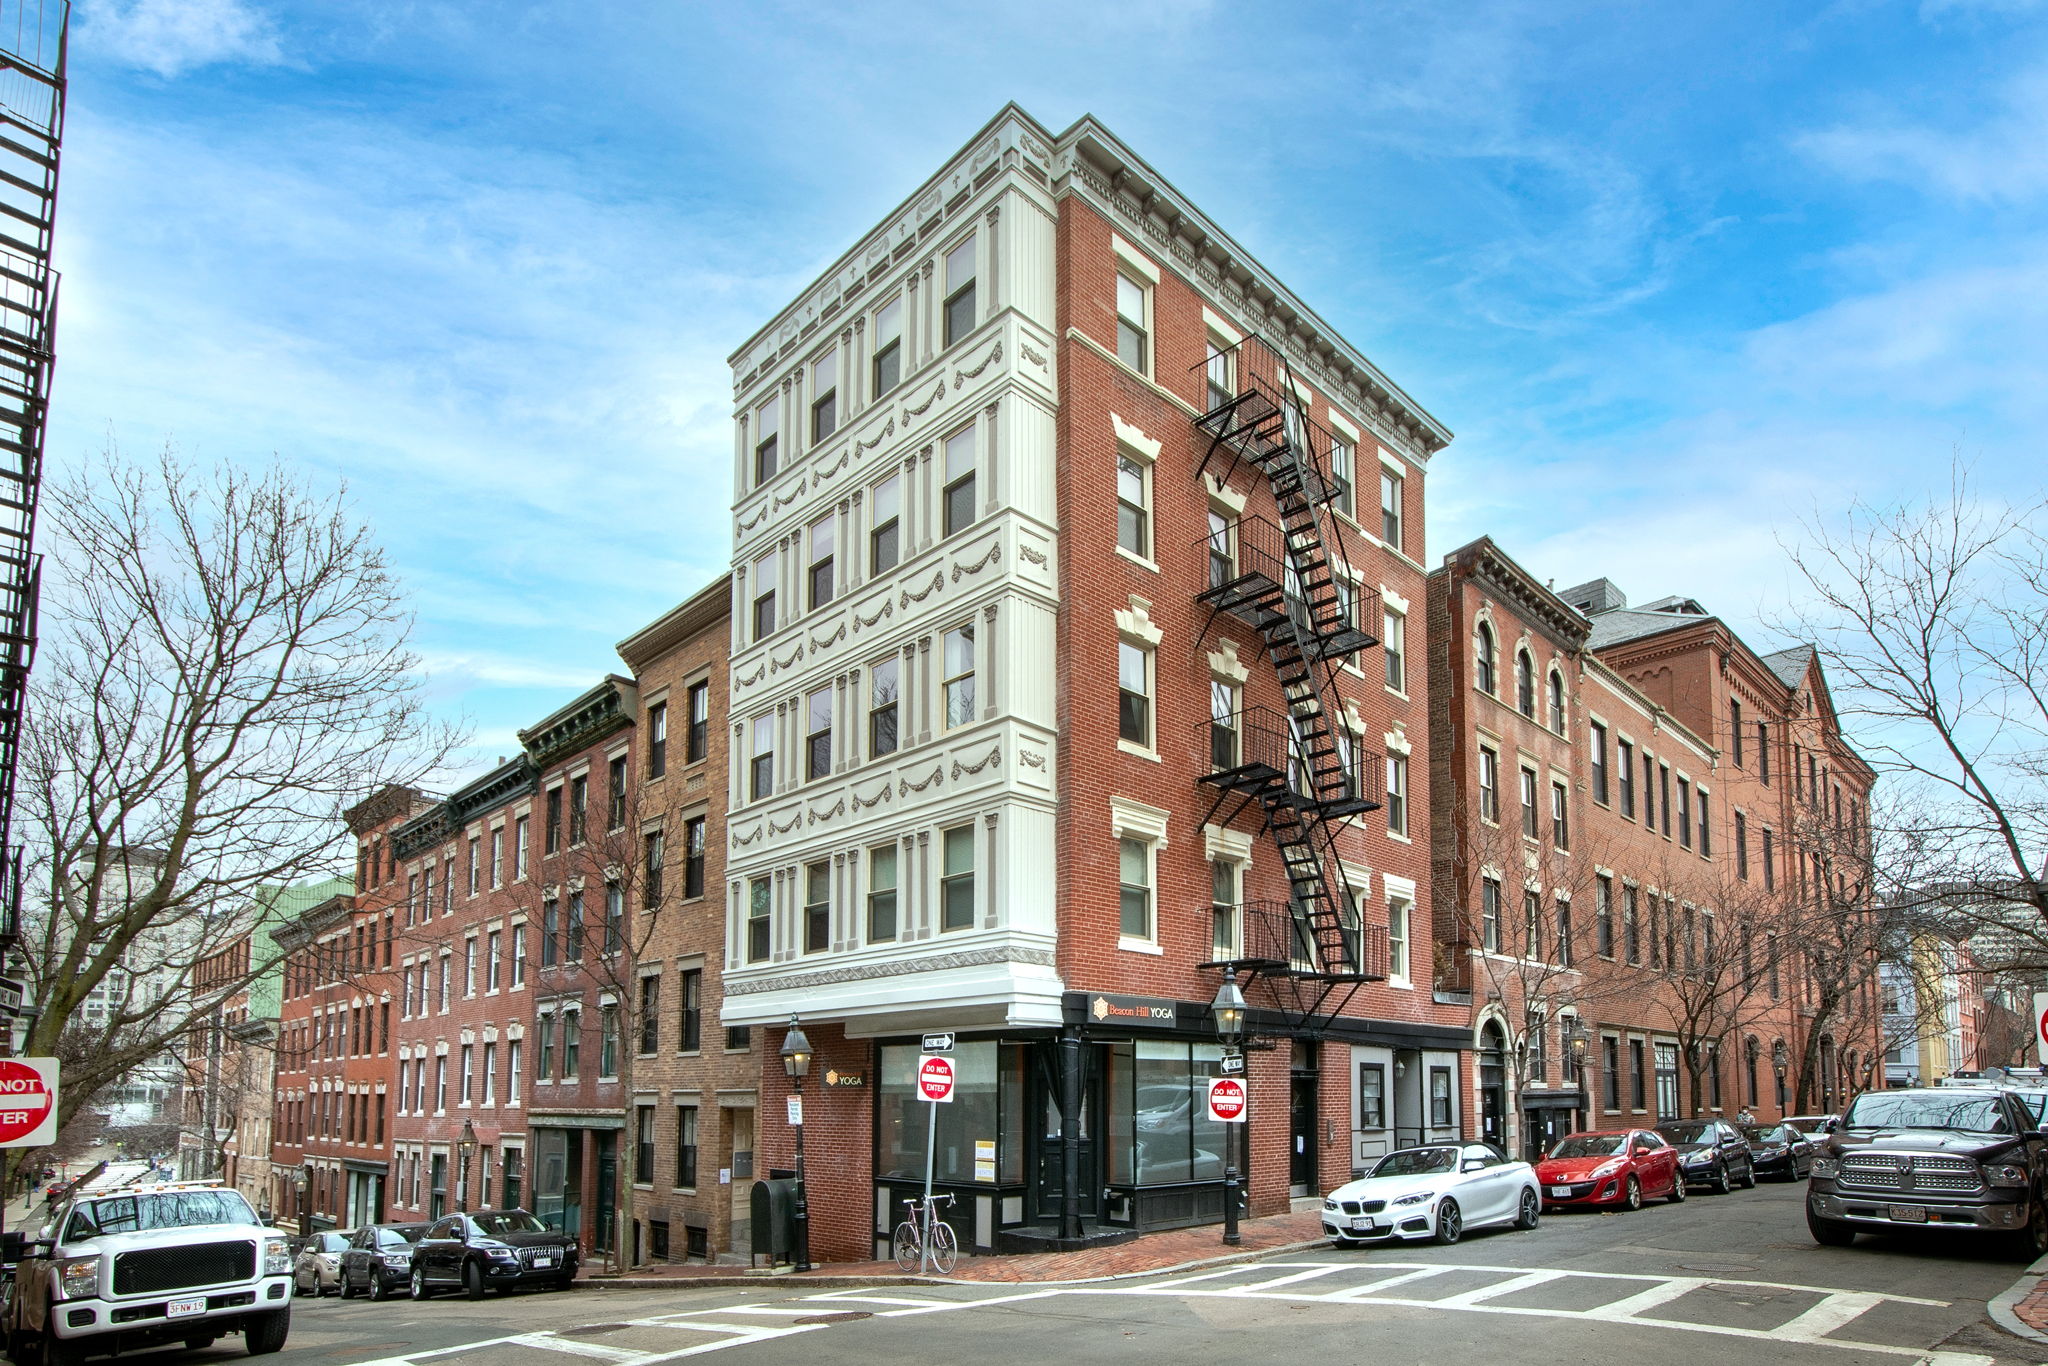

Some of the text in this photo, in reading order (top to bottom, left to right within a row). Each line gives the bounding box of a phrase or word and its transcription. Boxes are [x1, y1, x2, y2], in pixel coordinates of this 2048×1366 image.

[0, 988, 8, 1003] NE
[1109, 1004, 1174, 1019] Beacon Hill YOGA
[926, 1039, 934, 1047] ONE
[926, 1064, 949, 1074] DO NOT
[839, 1076, 862, 1085] YOGA
[0, 1079, 39, 1092] NOT
[926, 1083, 946, 1092] ENTER
[1226, 1088, 1240, 1096] NOT
